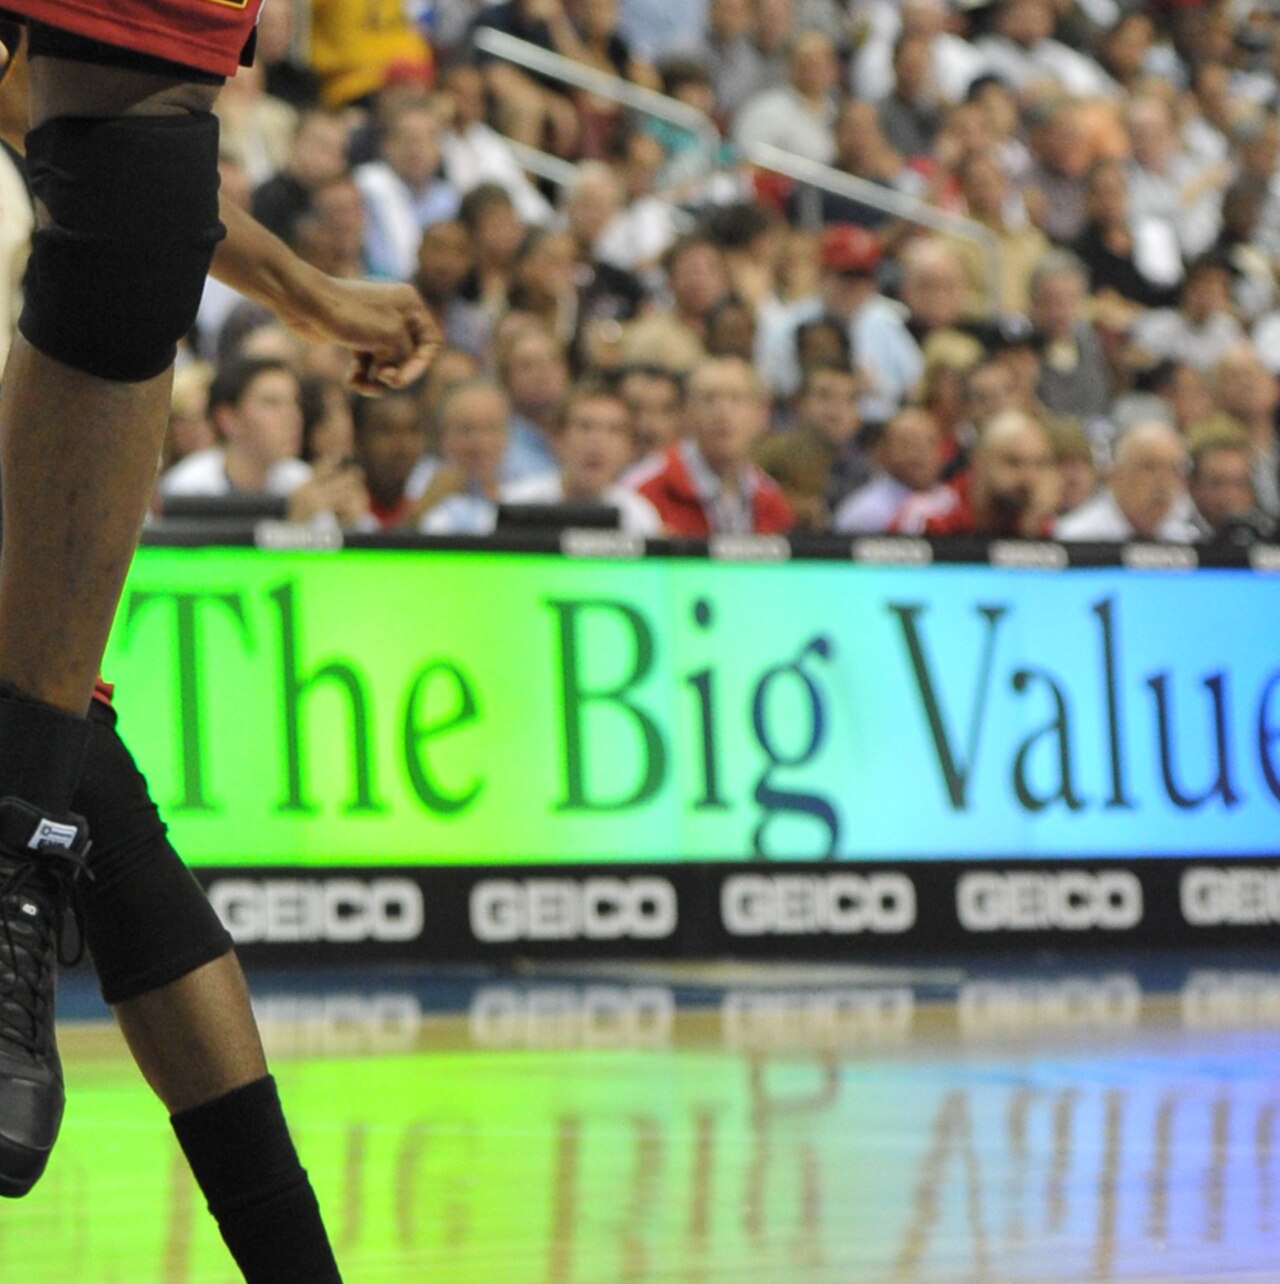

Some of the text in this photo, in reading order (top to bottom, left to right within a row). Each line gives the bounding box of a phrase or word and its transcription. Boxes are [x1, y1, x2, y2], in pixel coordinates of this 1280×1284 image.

[127, 582, 486, 816] The
[546, 593, 846, 859] Big
[208, 877, 424, 944] GEICO
[469, 875, 677, 942] GEICO
[722, 870, 917, 936] GEICO
[956, 869, 1144, 932] GEICO
